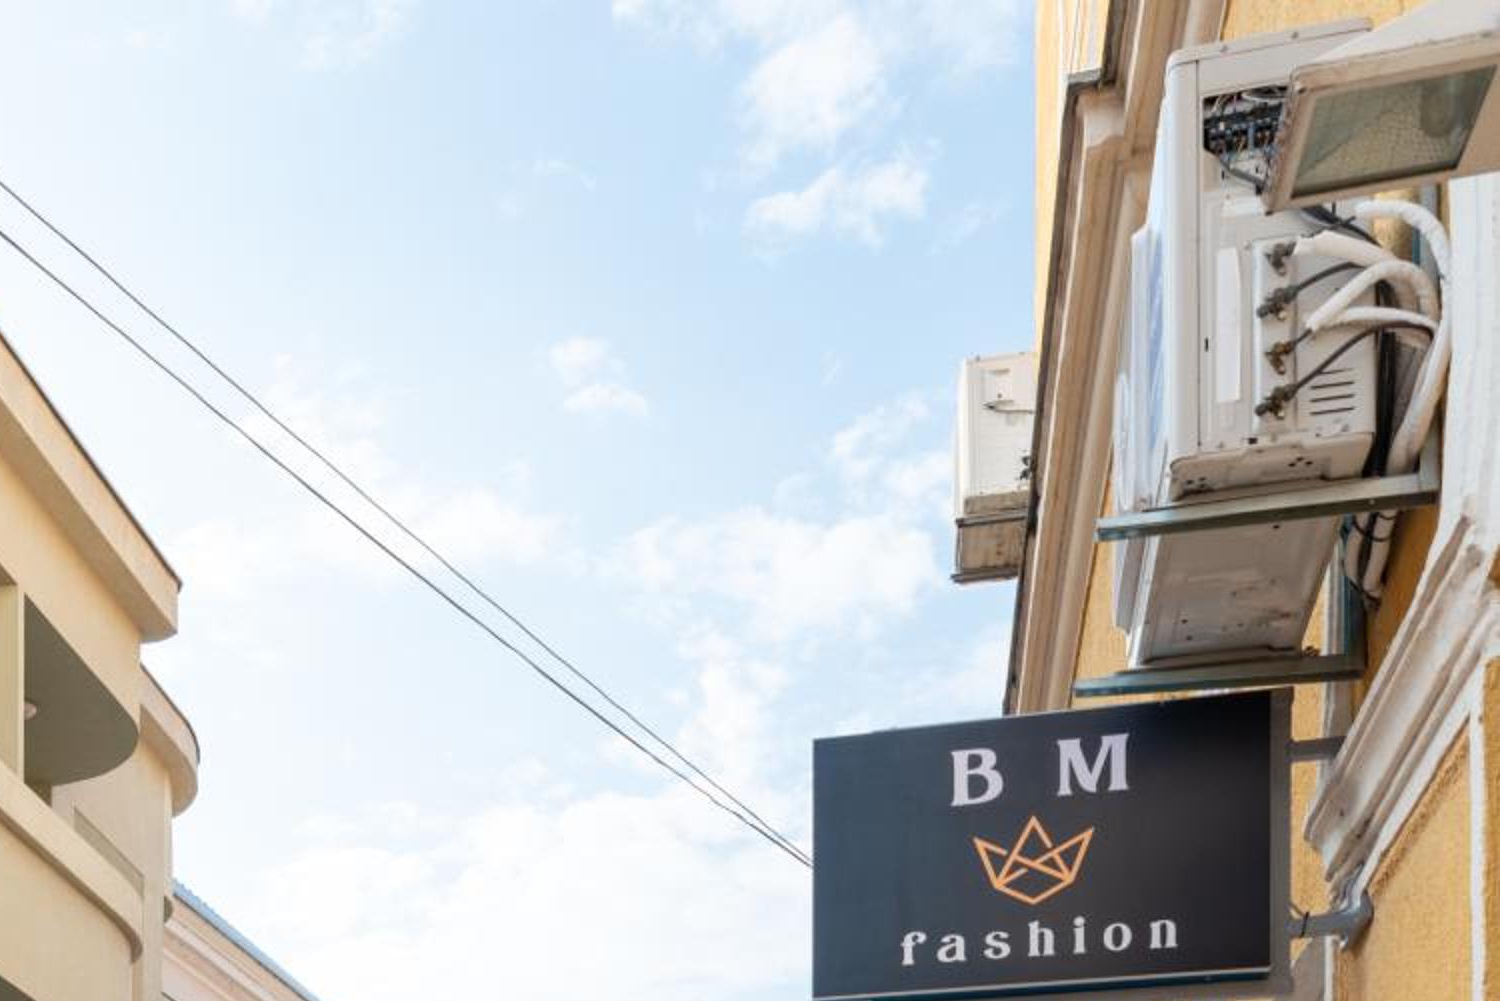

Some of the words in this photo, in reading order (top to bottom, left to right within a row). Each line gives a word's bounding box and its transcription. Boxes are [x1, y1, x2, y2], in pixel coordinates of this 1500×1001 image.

[949, 746, 1005, 807] B
[1056, 733, 1130, 797] M
[900, 916, 1179, 966] fashion
